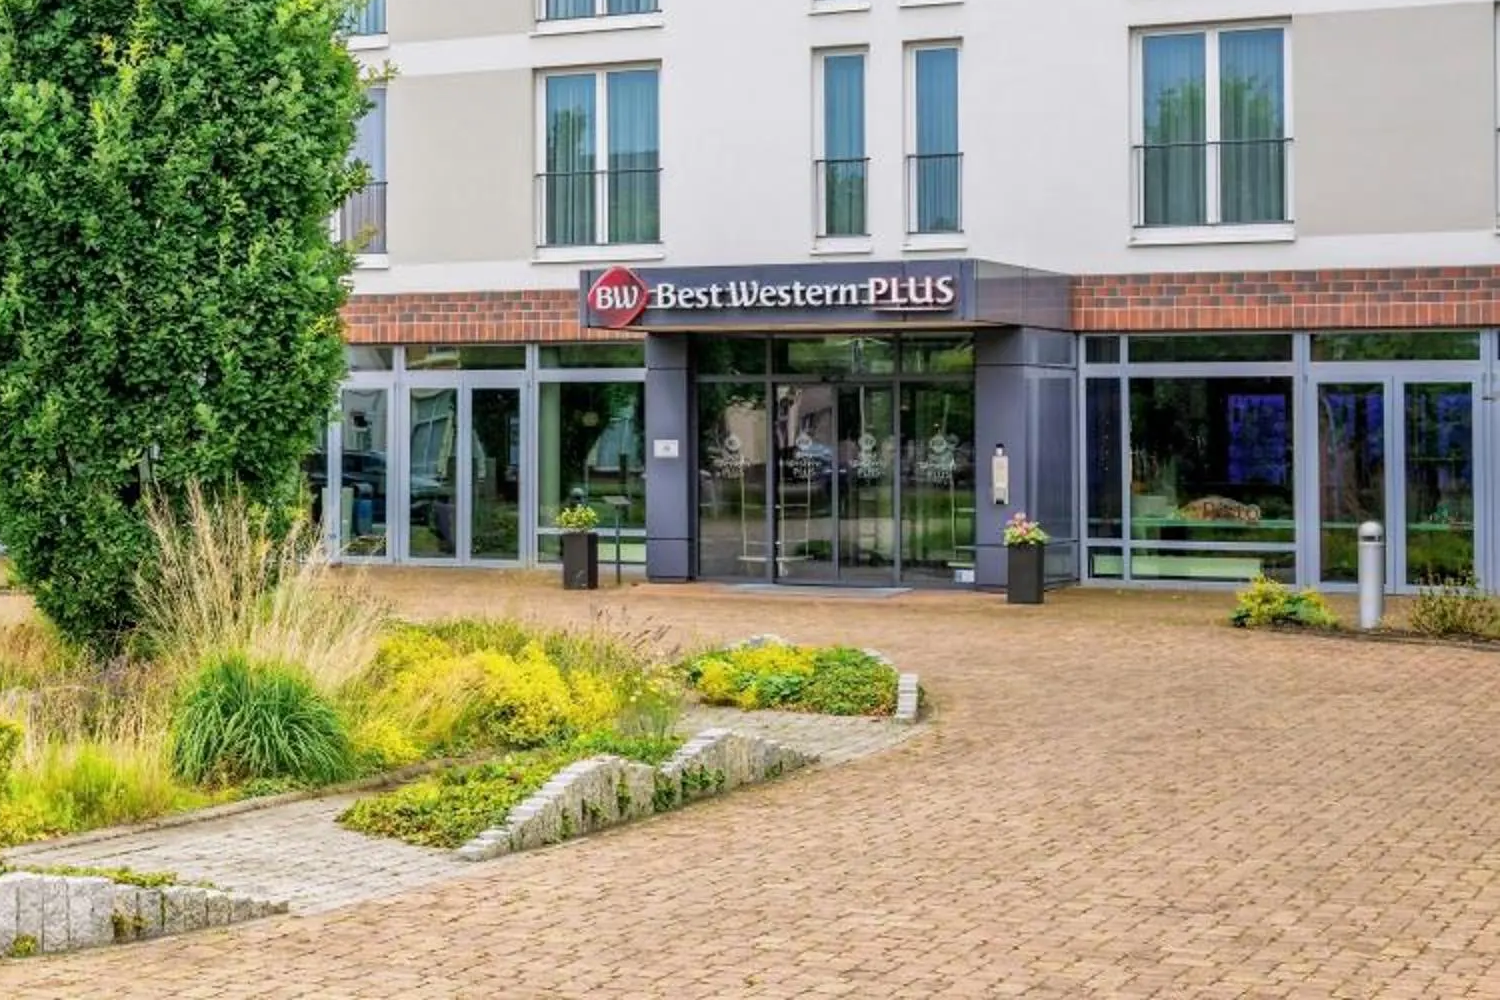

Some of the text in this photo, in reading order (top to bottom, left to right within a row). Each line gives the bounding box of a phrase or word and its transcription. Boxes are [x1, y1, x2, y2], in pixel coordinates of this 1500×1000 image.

[595, 276, 954, 309] BW Best Western PLUS
